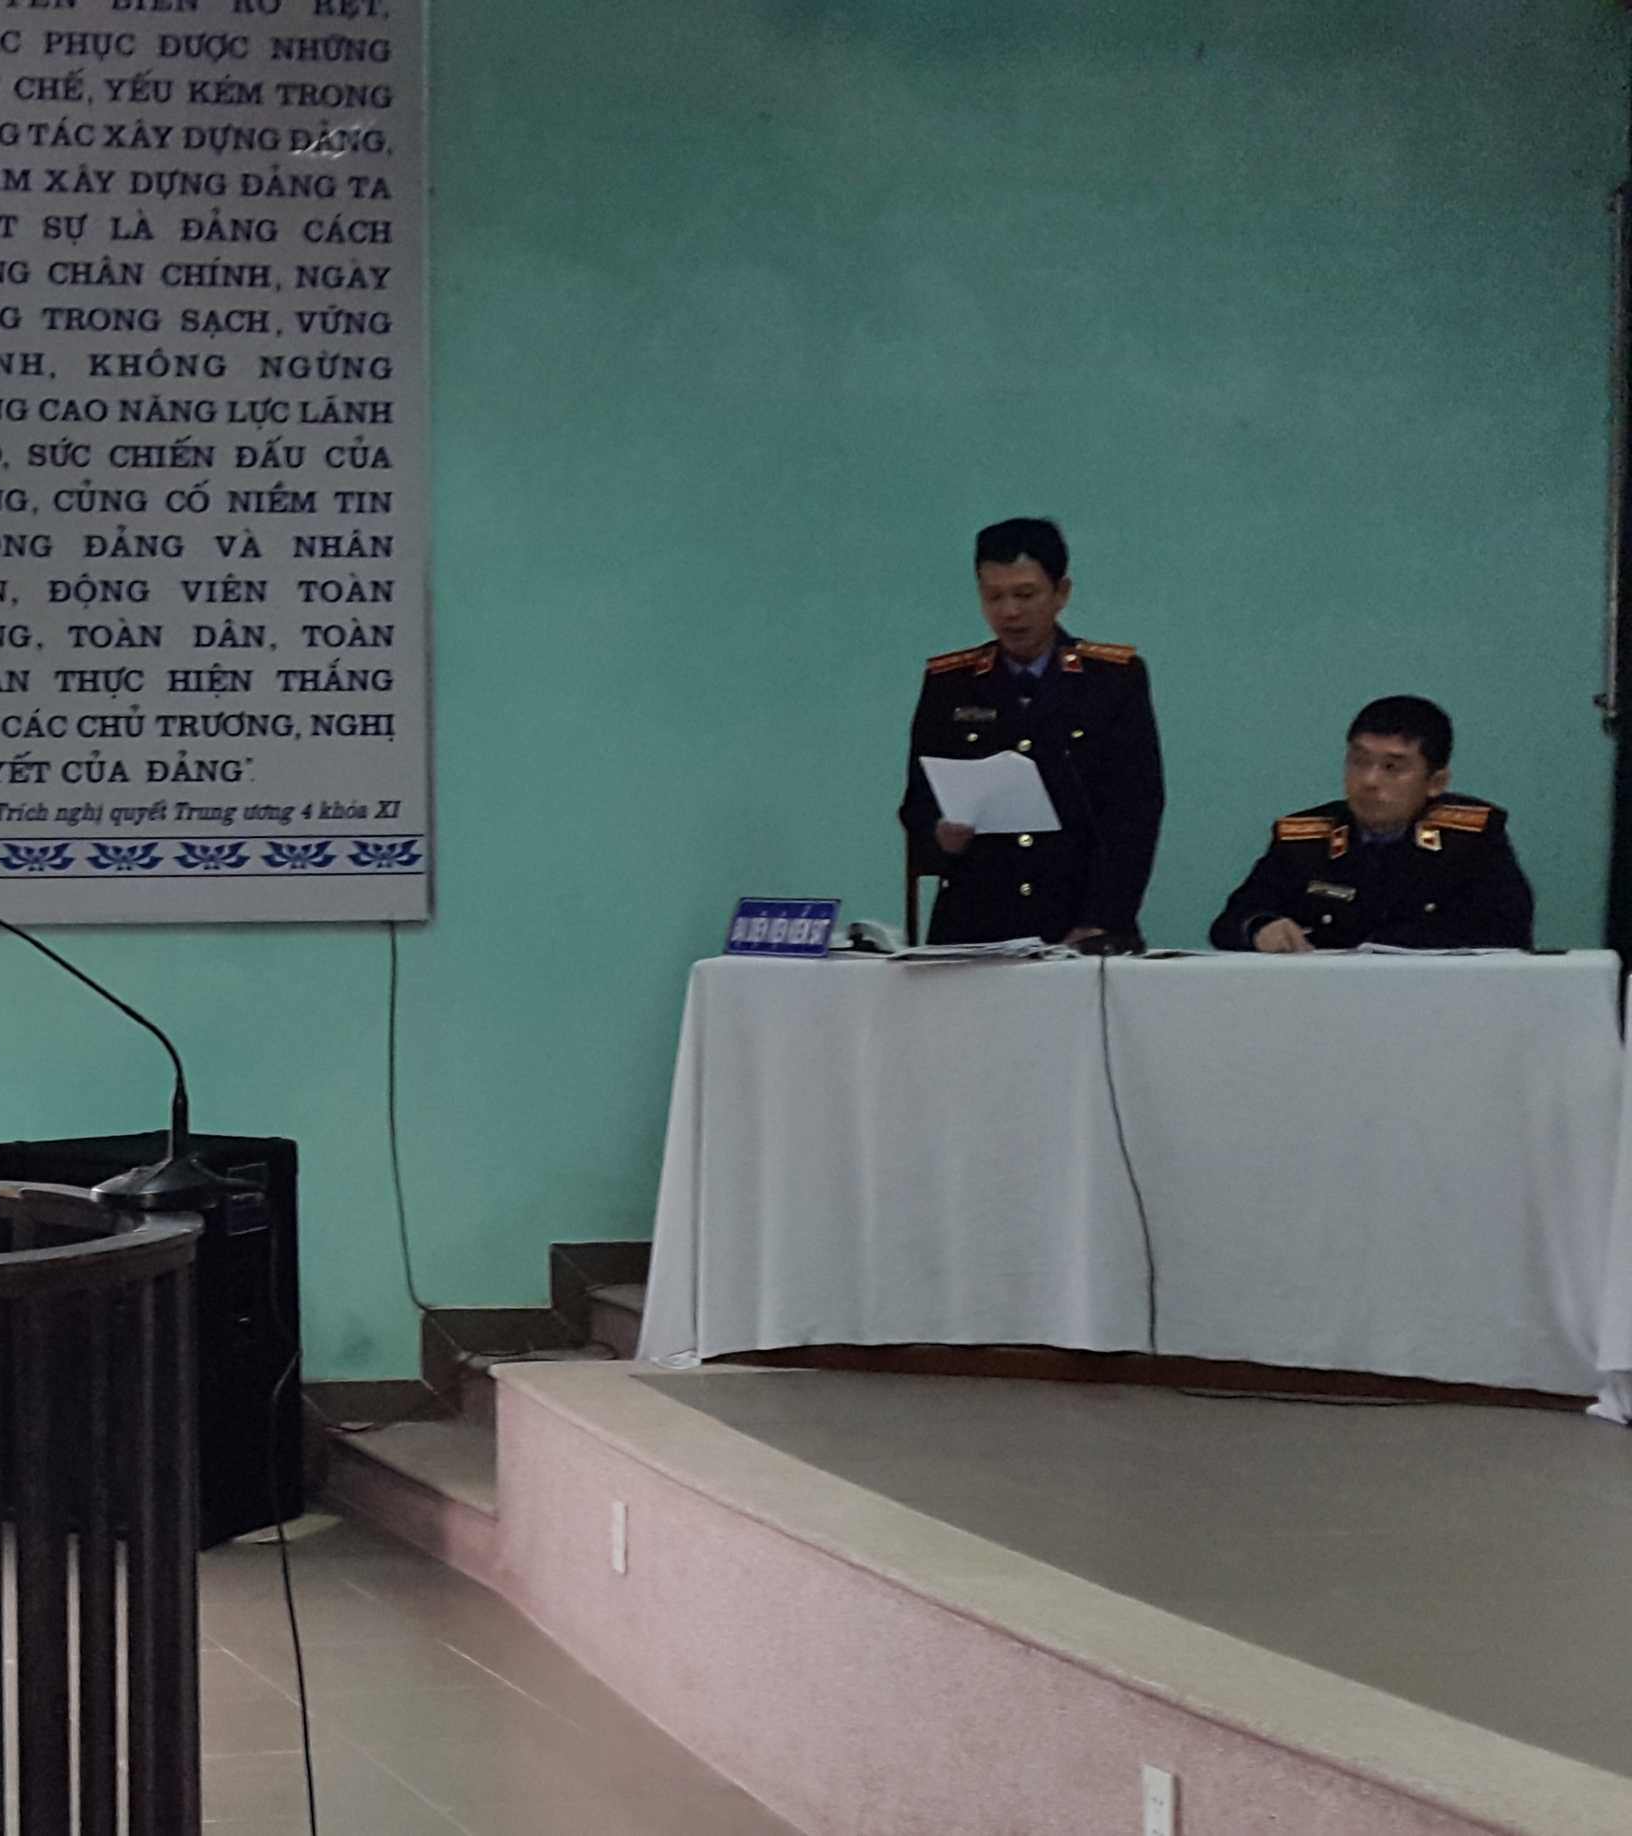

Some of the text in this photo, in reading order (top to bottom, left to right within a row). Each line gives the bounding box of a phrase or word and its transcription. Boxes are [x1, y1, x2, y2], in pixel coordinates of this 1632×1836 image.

[44, 31, 135, 61] PHỤC
[270, 35, 391, 63] NHỮNG
[14, 68, 92, 104] CHẾ,
[104, 70, 173, 103] YẾU
[189, 74, 263, 105] KÉM
[276, 83, 394, 109] TRONG
[28, 116, 94, 147] TÁC
[103, 119, 173, 149] XÂY
[183, 124, 281, 155] DỰNG
[44, 164, 115, 194] XÂY
[130, 169, 227, 200] DỰNG
[240, 164, 336, 199] ĐẢNG
[348, 176, 391, 200] TA
[43, 213, 88, 246] SỰ
[110, 208, 154, 240] LÀ
[181, 206, 278, 242] ĐẢNG
[303, 213, 392, 244] CÁCH
[48, 255, 144, 286] CHÂN
[160, 256, 281, 292] CHÍNH,
[296, 260, 391, 290] NGÀY
[41, 307, 162, 332] TRONG
[181, 309, 282, 339] SẠCH,
[294, 305, 392, 335] VỮNG
[88, 348, 227, 378] KHÔNG
[259, 351, 393, 380] NGỪNG
[39, 398, 108, 422] CAO
[118, 395, 217, 423] NĂNG
[227, 397, 289, 430] LỰC
[299, 395, 393, 424] LÃNH
[28, 437, 91, 467] SỨC
[109, 435, 215, 468] CHIẾN
[236, 436, 306, 468] ĐẤU
[325, 435, 393, 469] CỦA
[53, 479, 148, 512] CỦNG
[165, 480, 210, 513] CỐ
[333, 491, 392, 514] TIN
[83, 524, 184, 558] ĐẢNG
[214, 528, 262, 558] VÀ
[293, 529, 393, 558] NHÂN
[48, 573, 150, 608] ĐỘNG
[180, 573, 268, 603] VIÊN
[297, 573, 395, 603] TOÀN
[68, 618, 163, 648] TOÀN
[193, 618, 277, 651] DÂN,
[301, 617, 394, 647] TOÀN
[54, 666, 144, 699] THỰC
[168, 663, 253, 698] HIỆN
[276, 658, 394, 692] THẮNG
[1, 708, 67, 738] CÁC
[77, 704, 146, 738] CHỦ
[155, 711, 301, 741] TRƯƠNG,
[310, 714, 396, 742] NGHỊ
[61, 750, 130, 784] CỦA
[174, 802, 237, 826] Trung
[301, 803, 313, 820] 4
[374, 800, 402, 819] XI
